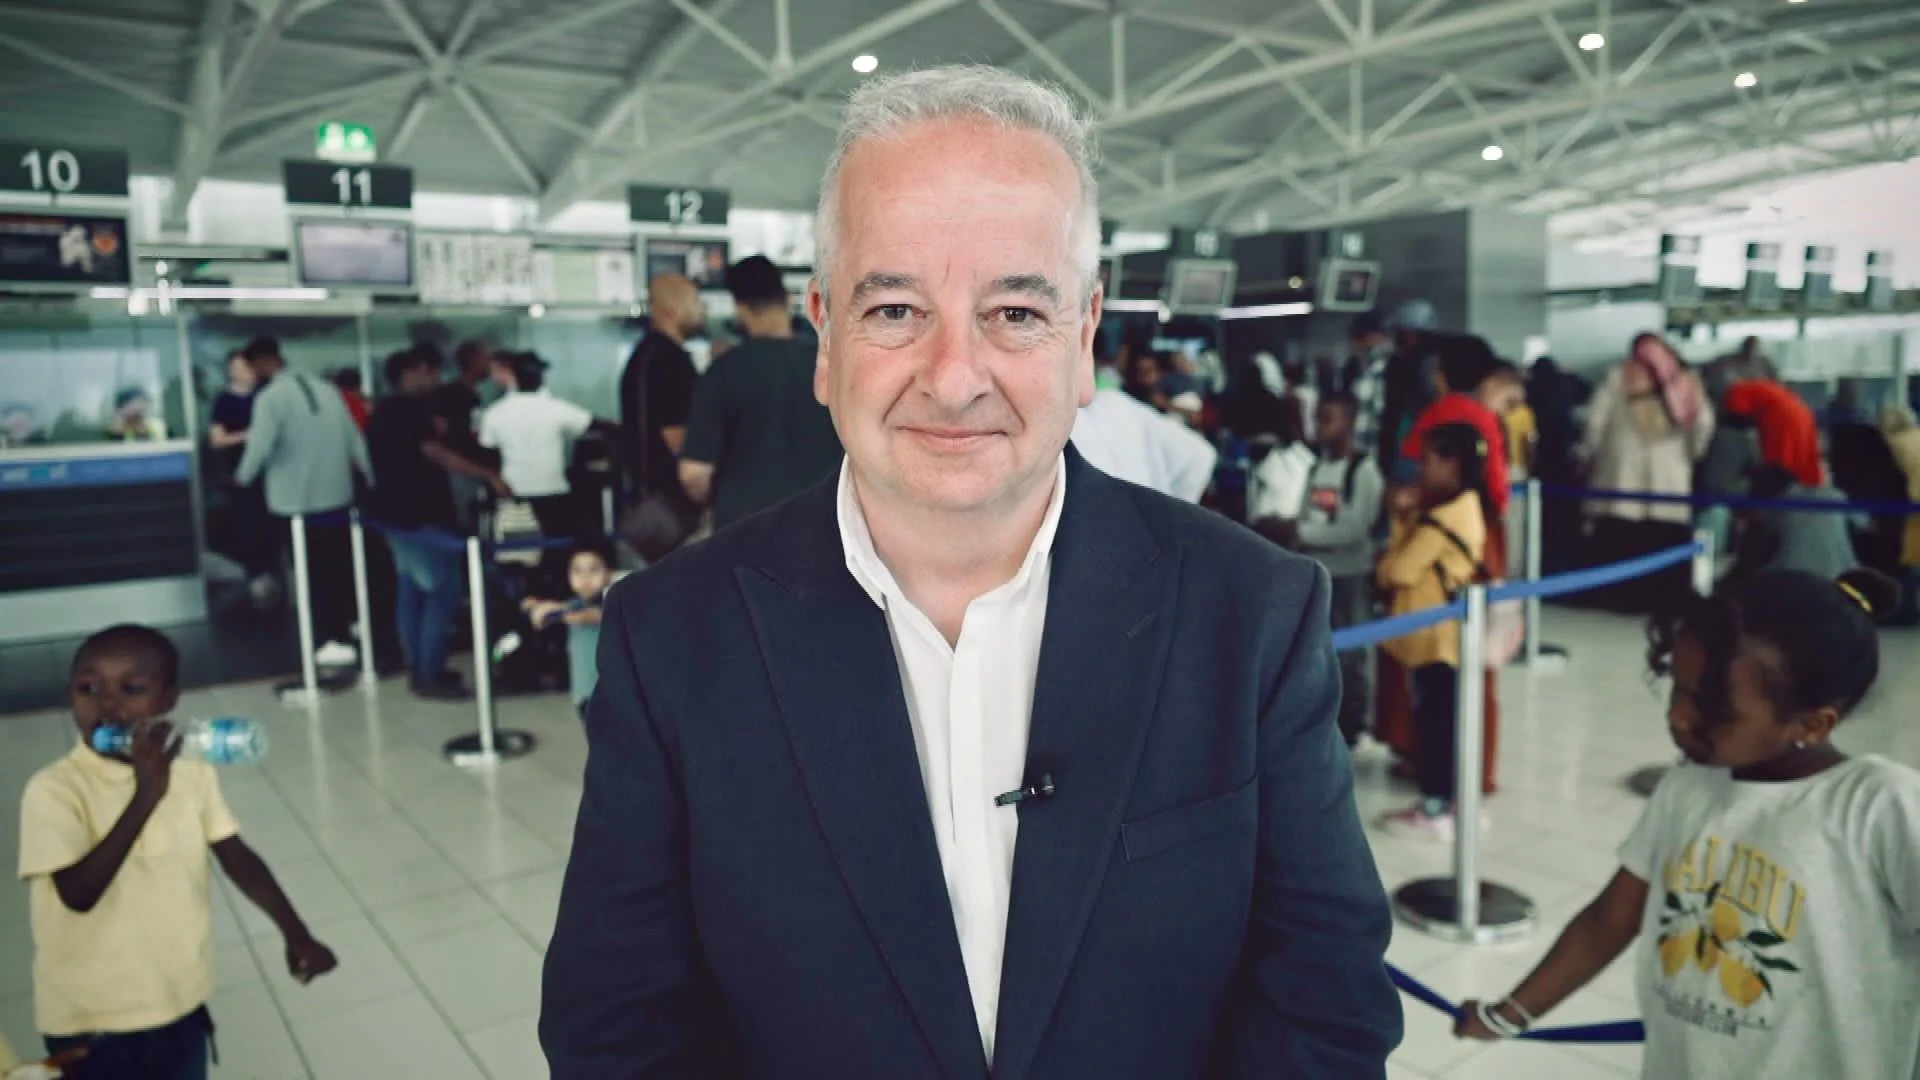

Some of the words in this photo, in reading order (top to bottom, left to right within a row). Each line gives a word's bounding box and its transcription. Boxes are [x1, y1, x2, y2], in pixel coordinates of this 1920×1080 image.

[20, 149, 80, 192] 10
[331, 168, 372, 206] 11
[664, 190, 703, 225] 12
